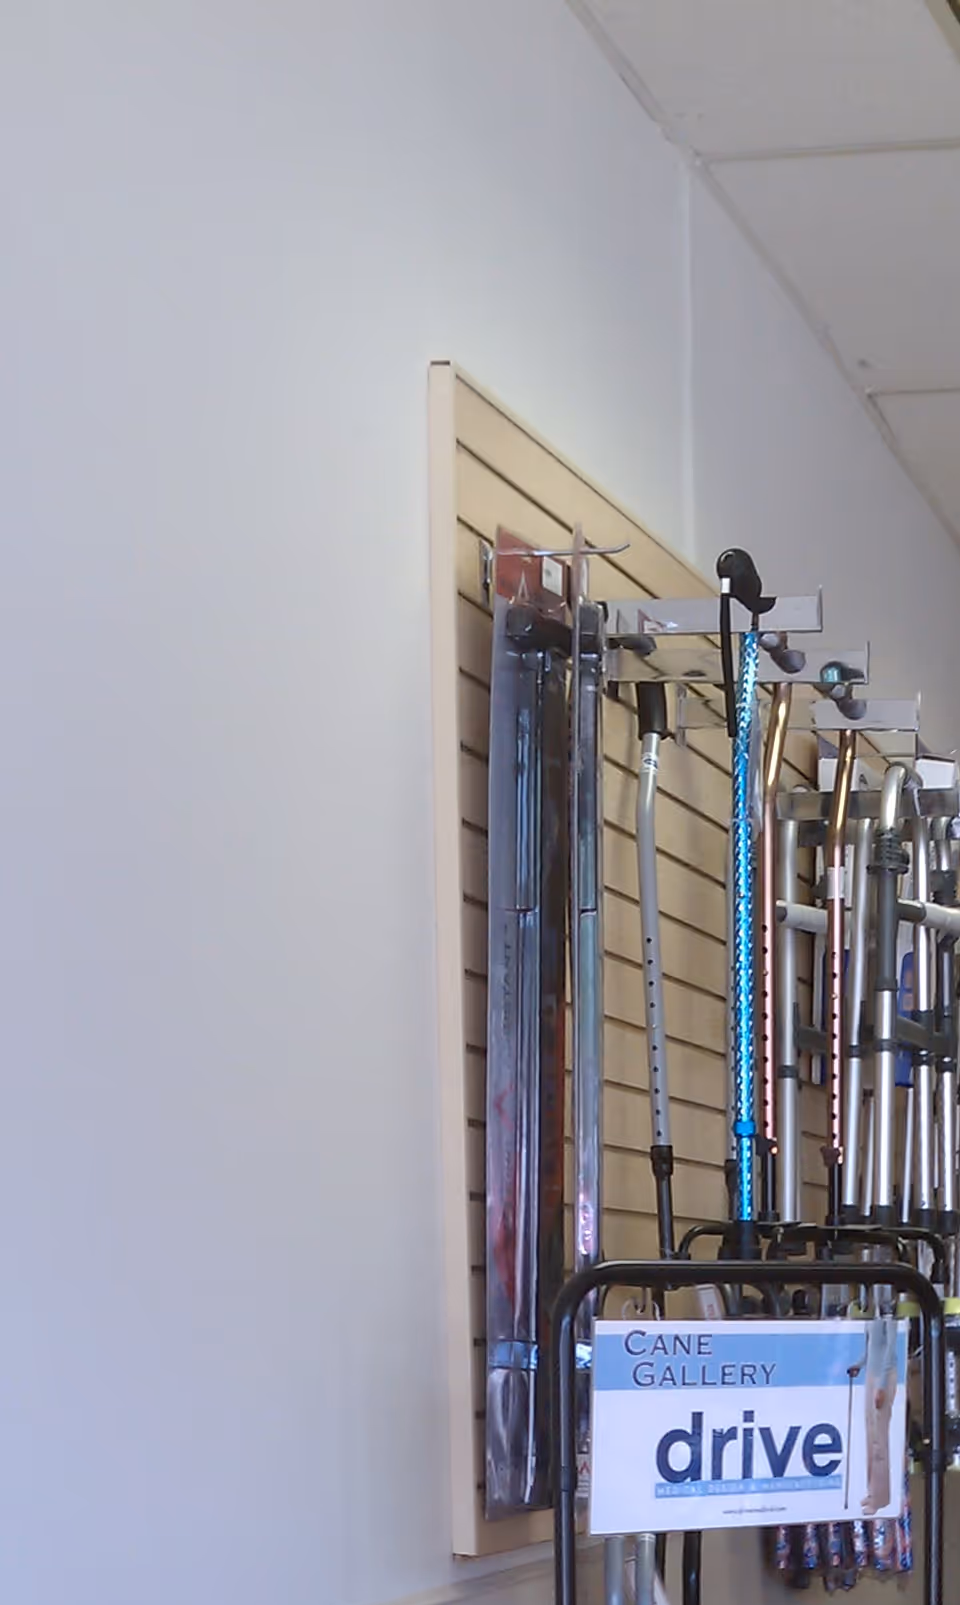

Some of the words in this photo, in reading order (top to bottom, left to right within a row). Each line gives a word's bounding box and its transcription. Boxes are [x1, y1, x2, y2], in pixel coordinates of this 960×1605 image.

[623, 1329, 713, 1357] CANE
[631, 1361, 777, 1387] GALLERY
[655, 1410, 844, 1485] drive
